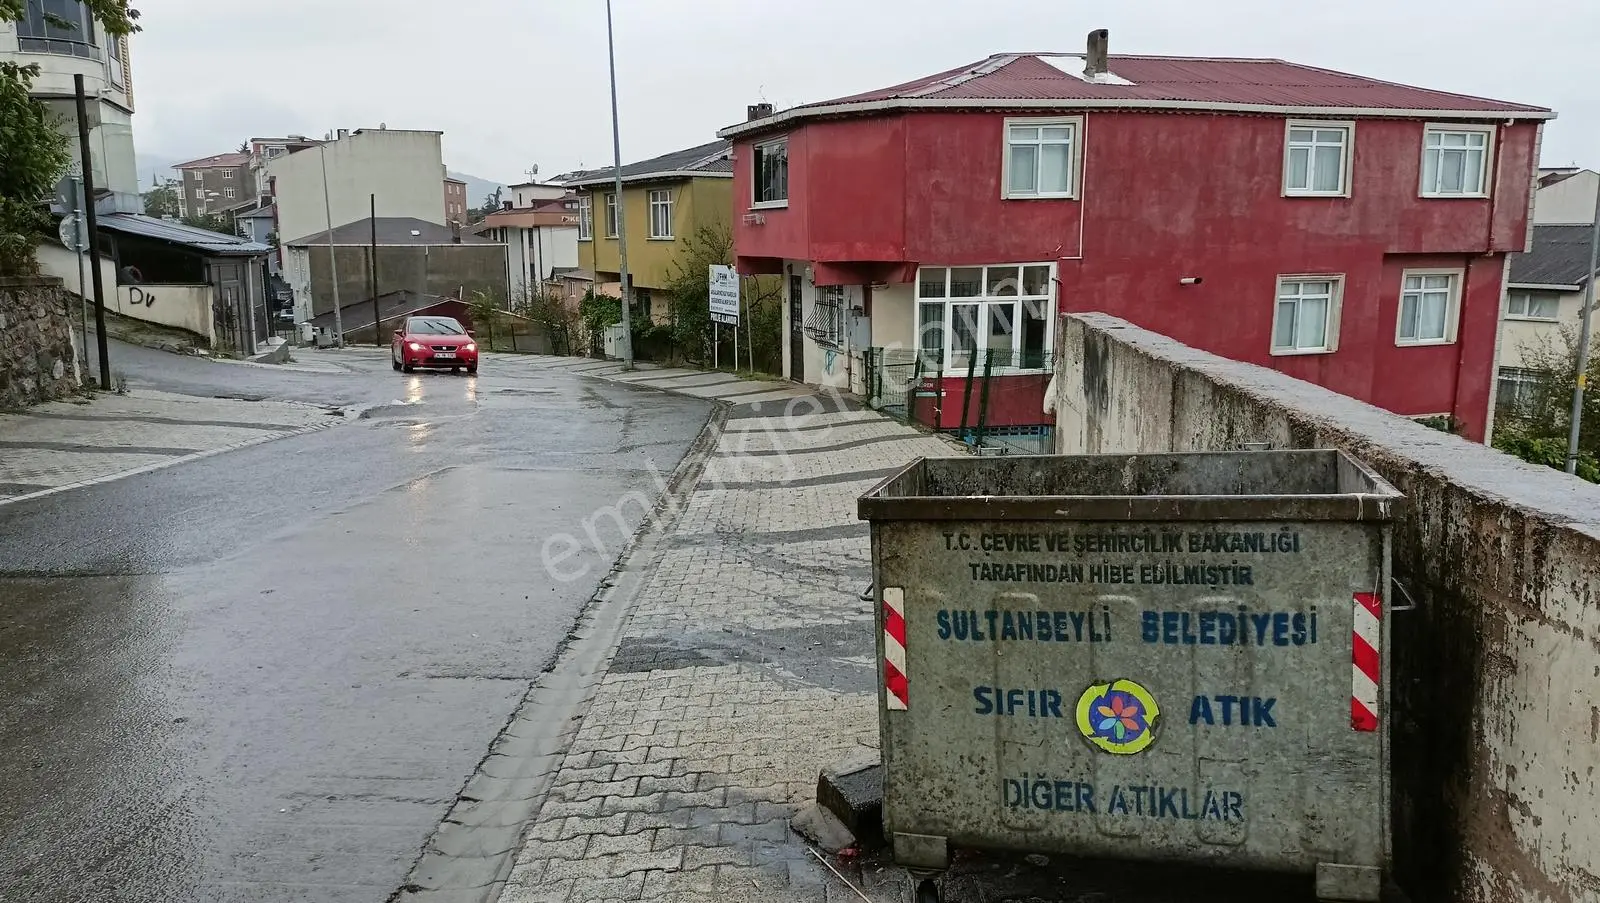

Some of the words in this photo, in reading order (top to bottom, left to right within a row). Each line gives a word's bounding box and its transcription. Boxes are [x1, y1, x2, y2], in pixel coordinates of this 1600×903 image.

[980, 532, 1041, 557] ÇEVRE
[1044, 534, 1070, 553] VE
[1188, 526, 1301, 554] BAKANLIĞI
[969, 562, 1085, 584] TARAFINDAN
[1089, 559, 1135, 584] HİBE
[1140, 560, 1254, 591] EDİLMİŞTİR
[936, 605, 1112, 643] SULTANBEYLİ
[1142, 605, 1318, 647] BELEDİYESİ
[973, 686, 1063, 718] SIFIR
[1188, 694, 1277, 728] ATIK
[1002, 772, 1097, 814] DİĞER
[1109, 784, 1244, 823] ATIKLAR
